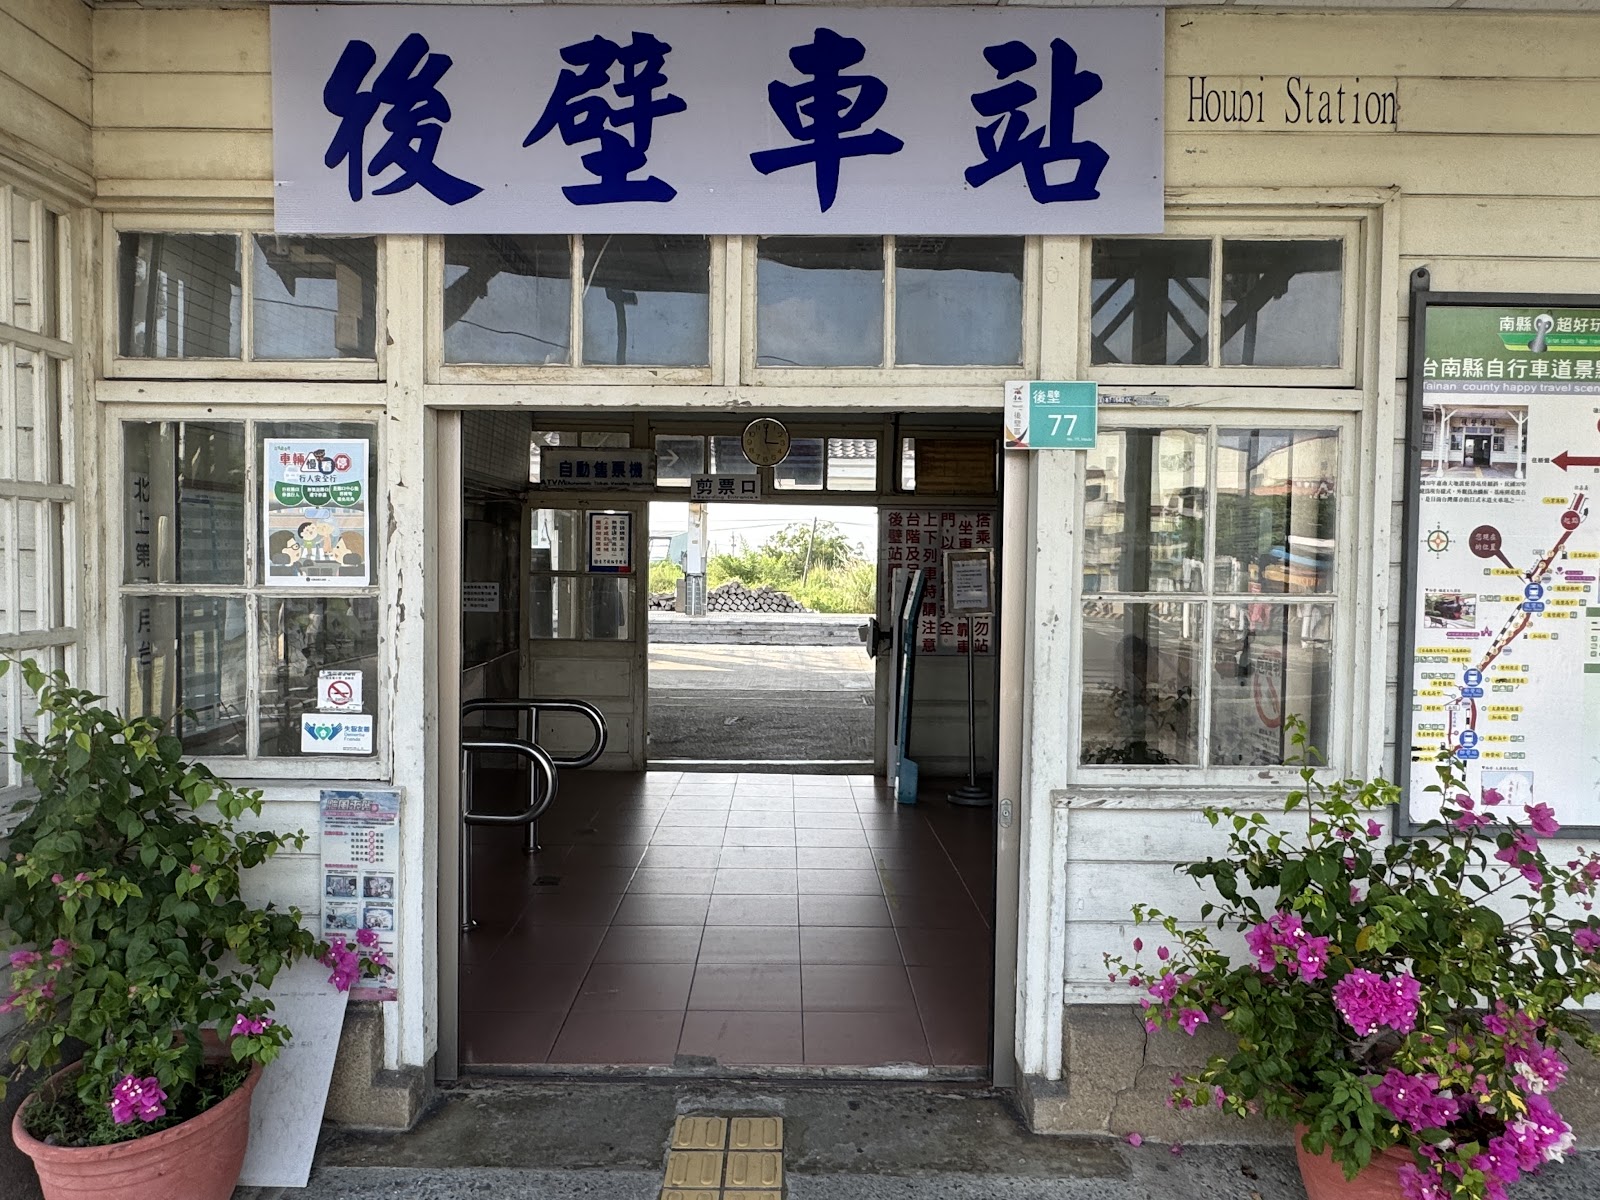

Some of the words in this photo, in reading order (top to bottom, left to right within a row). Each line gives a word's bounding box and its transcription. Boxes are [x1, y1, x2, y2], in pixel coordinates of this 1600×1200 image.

[1187, 76, 1265, 123] Houbi
[1285, 76, 1397, 125] Station
[324, 28, 1110, 212] 後壁車站
[1500, 316, 1532, 332] 南縣
[1462, 383, 1500, 393] county
[1503, 383, 1537, 393] happy
[1540, 383, 1571, 392] travel
[1032, 389, 1061, 404] 後壁
[1048, 414, 1077, 436] 77
[559, 461, 643, 478] 自動售票機
[299, 474, 337, 483] 行人安全行
[696, 478, 756, 495] 剪票口
[1475, 533, 1497, 541] 您現在
[1474, 543, 1496, 551] 的位置
[922, 513, 938, 653] 上下列車時請注意
